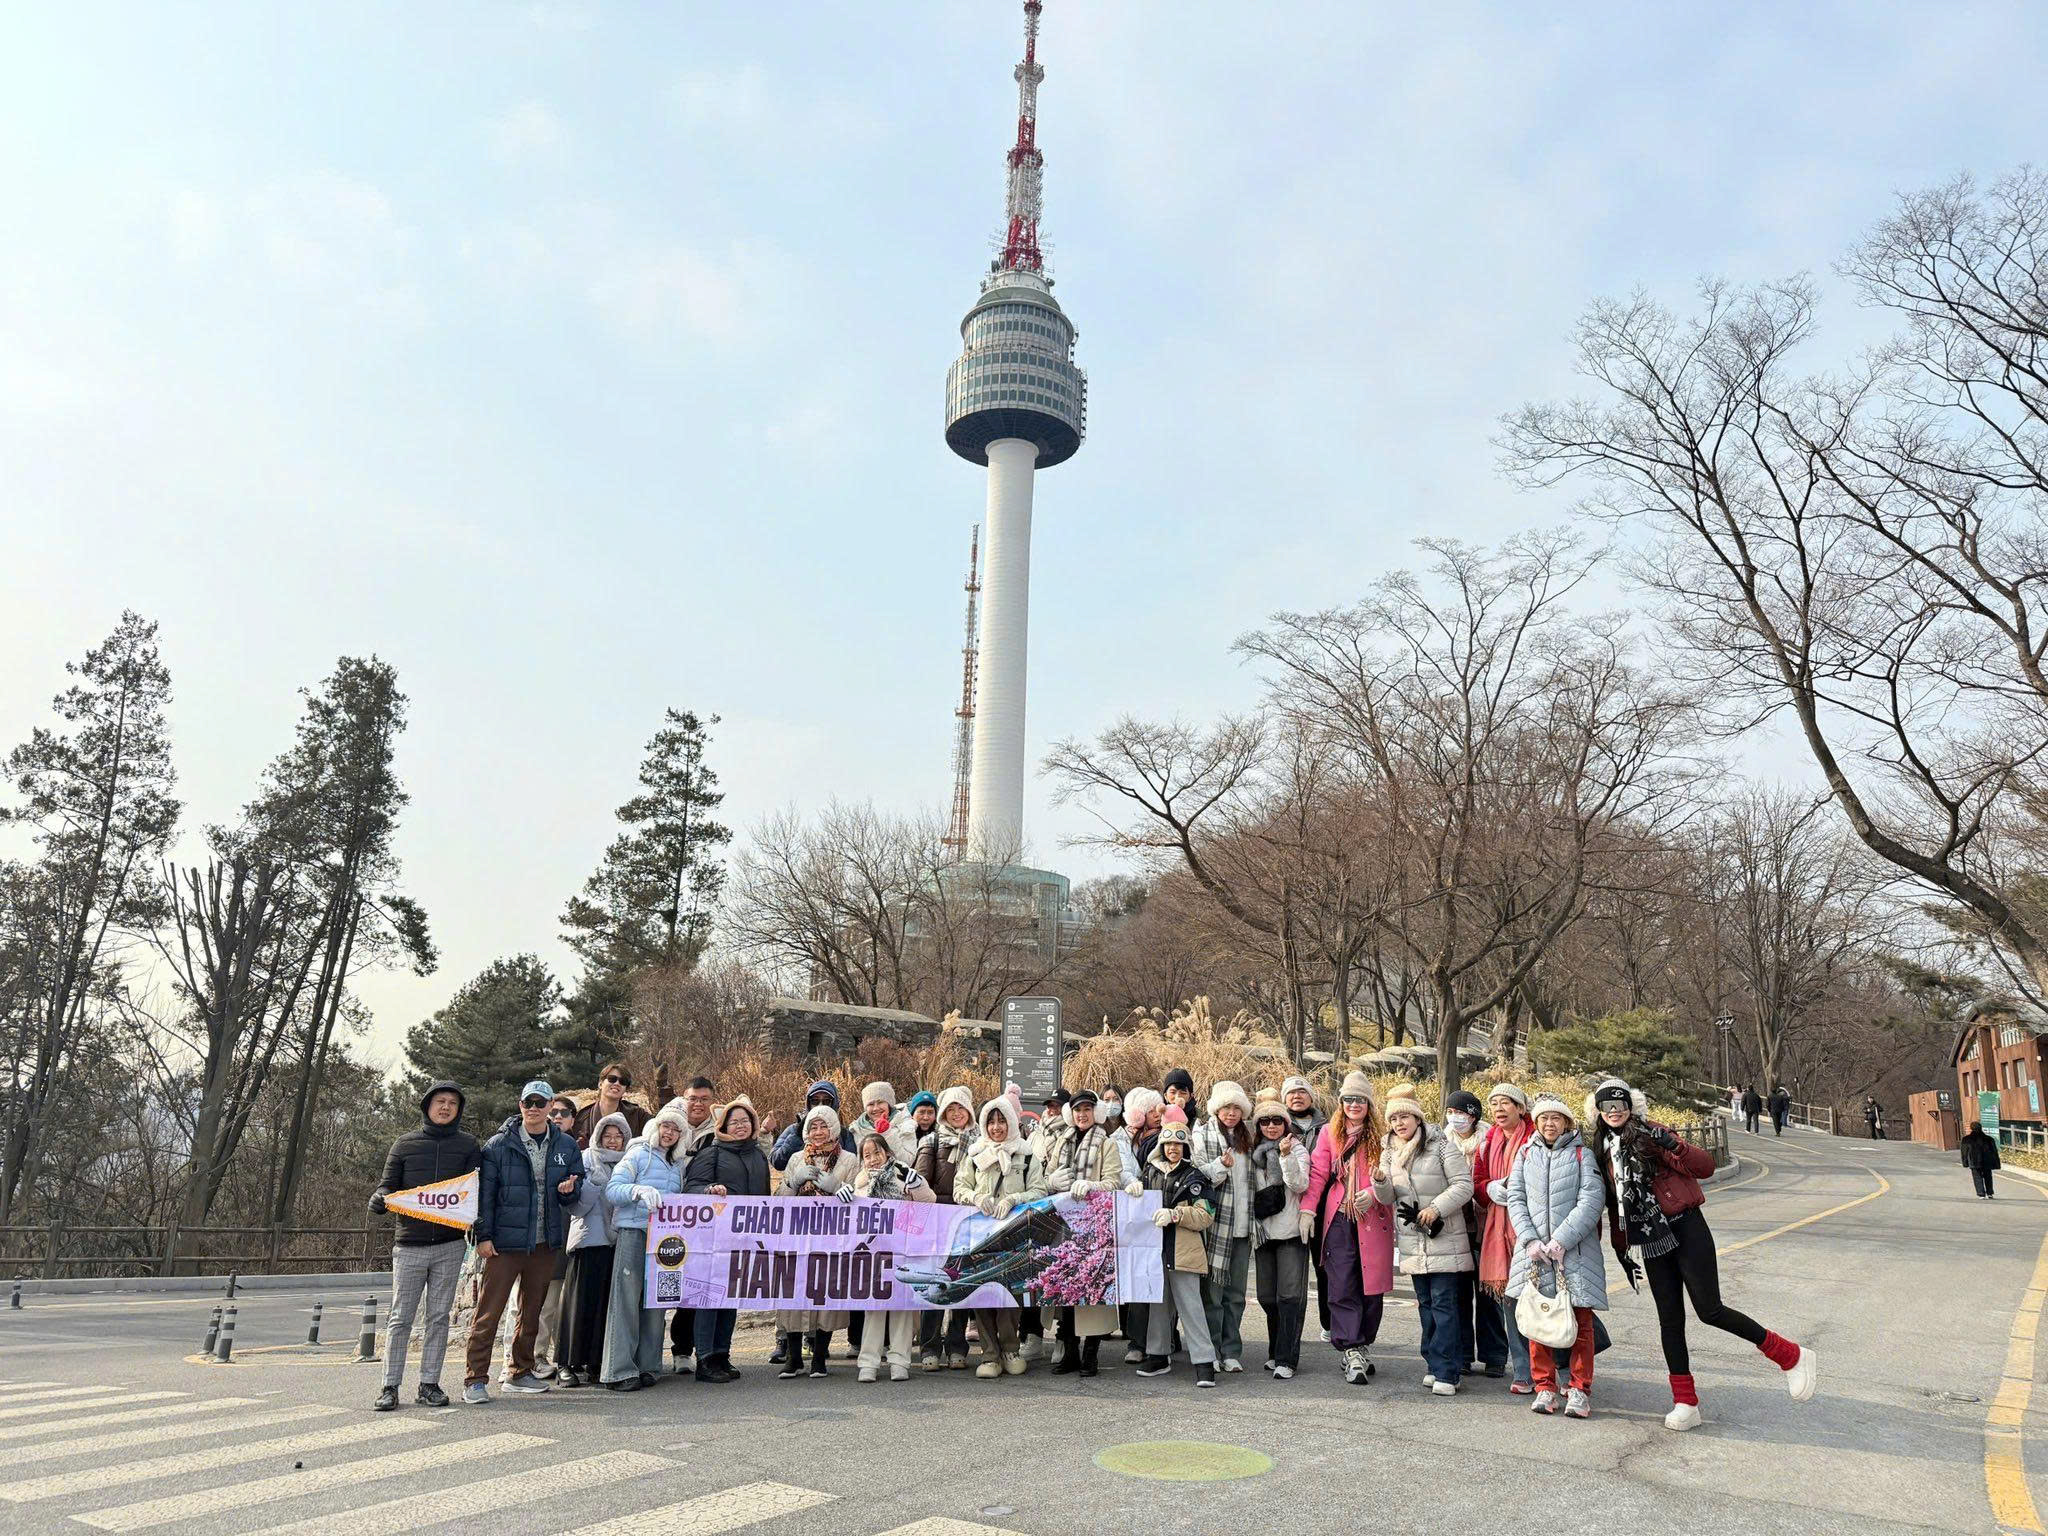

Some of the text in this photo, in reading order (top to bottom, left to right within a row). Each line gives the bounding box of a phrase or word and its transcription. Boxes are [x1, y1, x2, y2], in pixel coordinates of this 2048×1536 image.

[418, 1192, 459, 1210] tugo
[657, 1201, 714, 1228] tugo
[731, 1201, 895, 1235] CHÀO MỪNG ĐẾN
[660, 1247, 679, 1256] tugo
[727, 1236, 893, 1305] HÀN QUỐC
